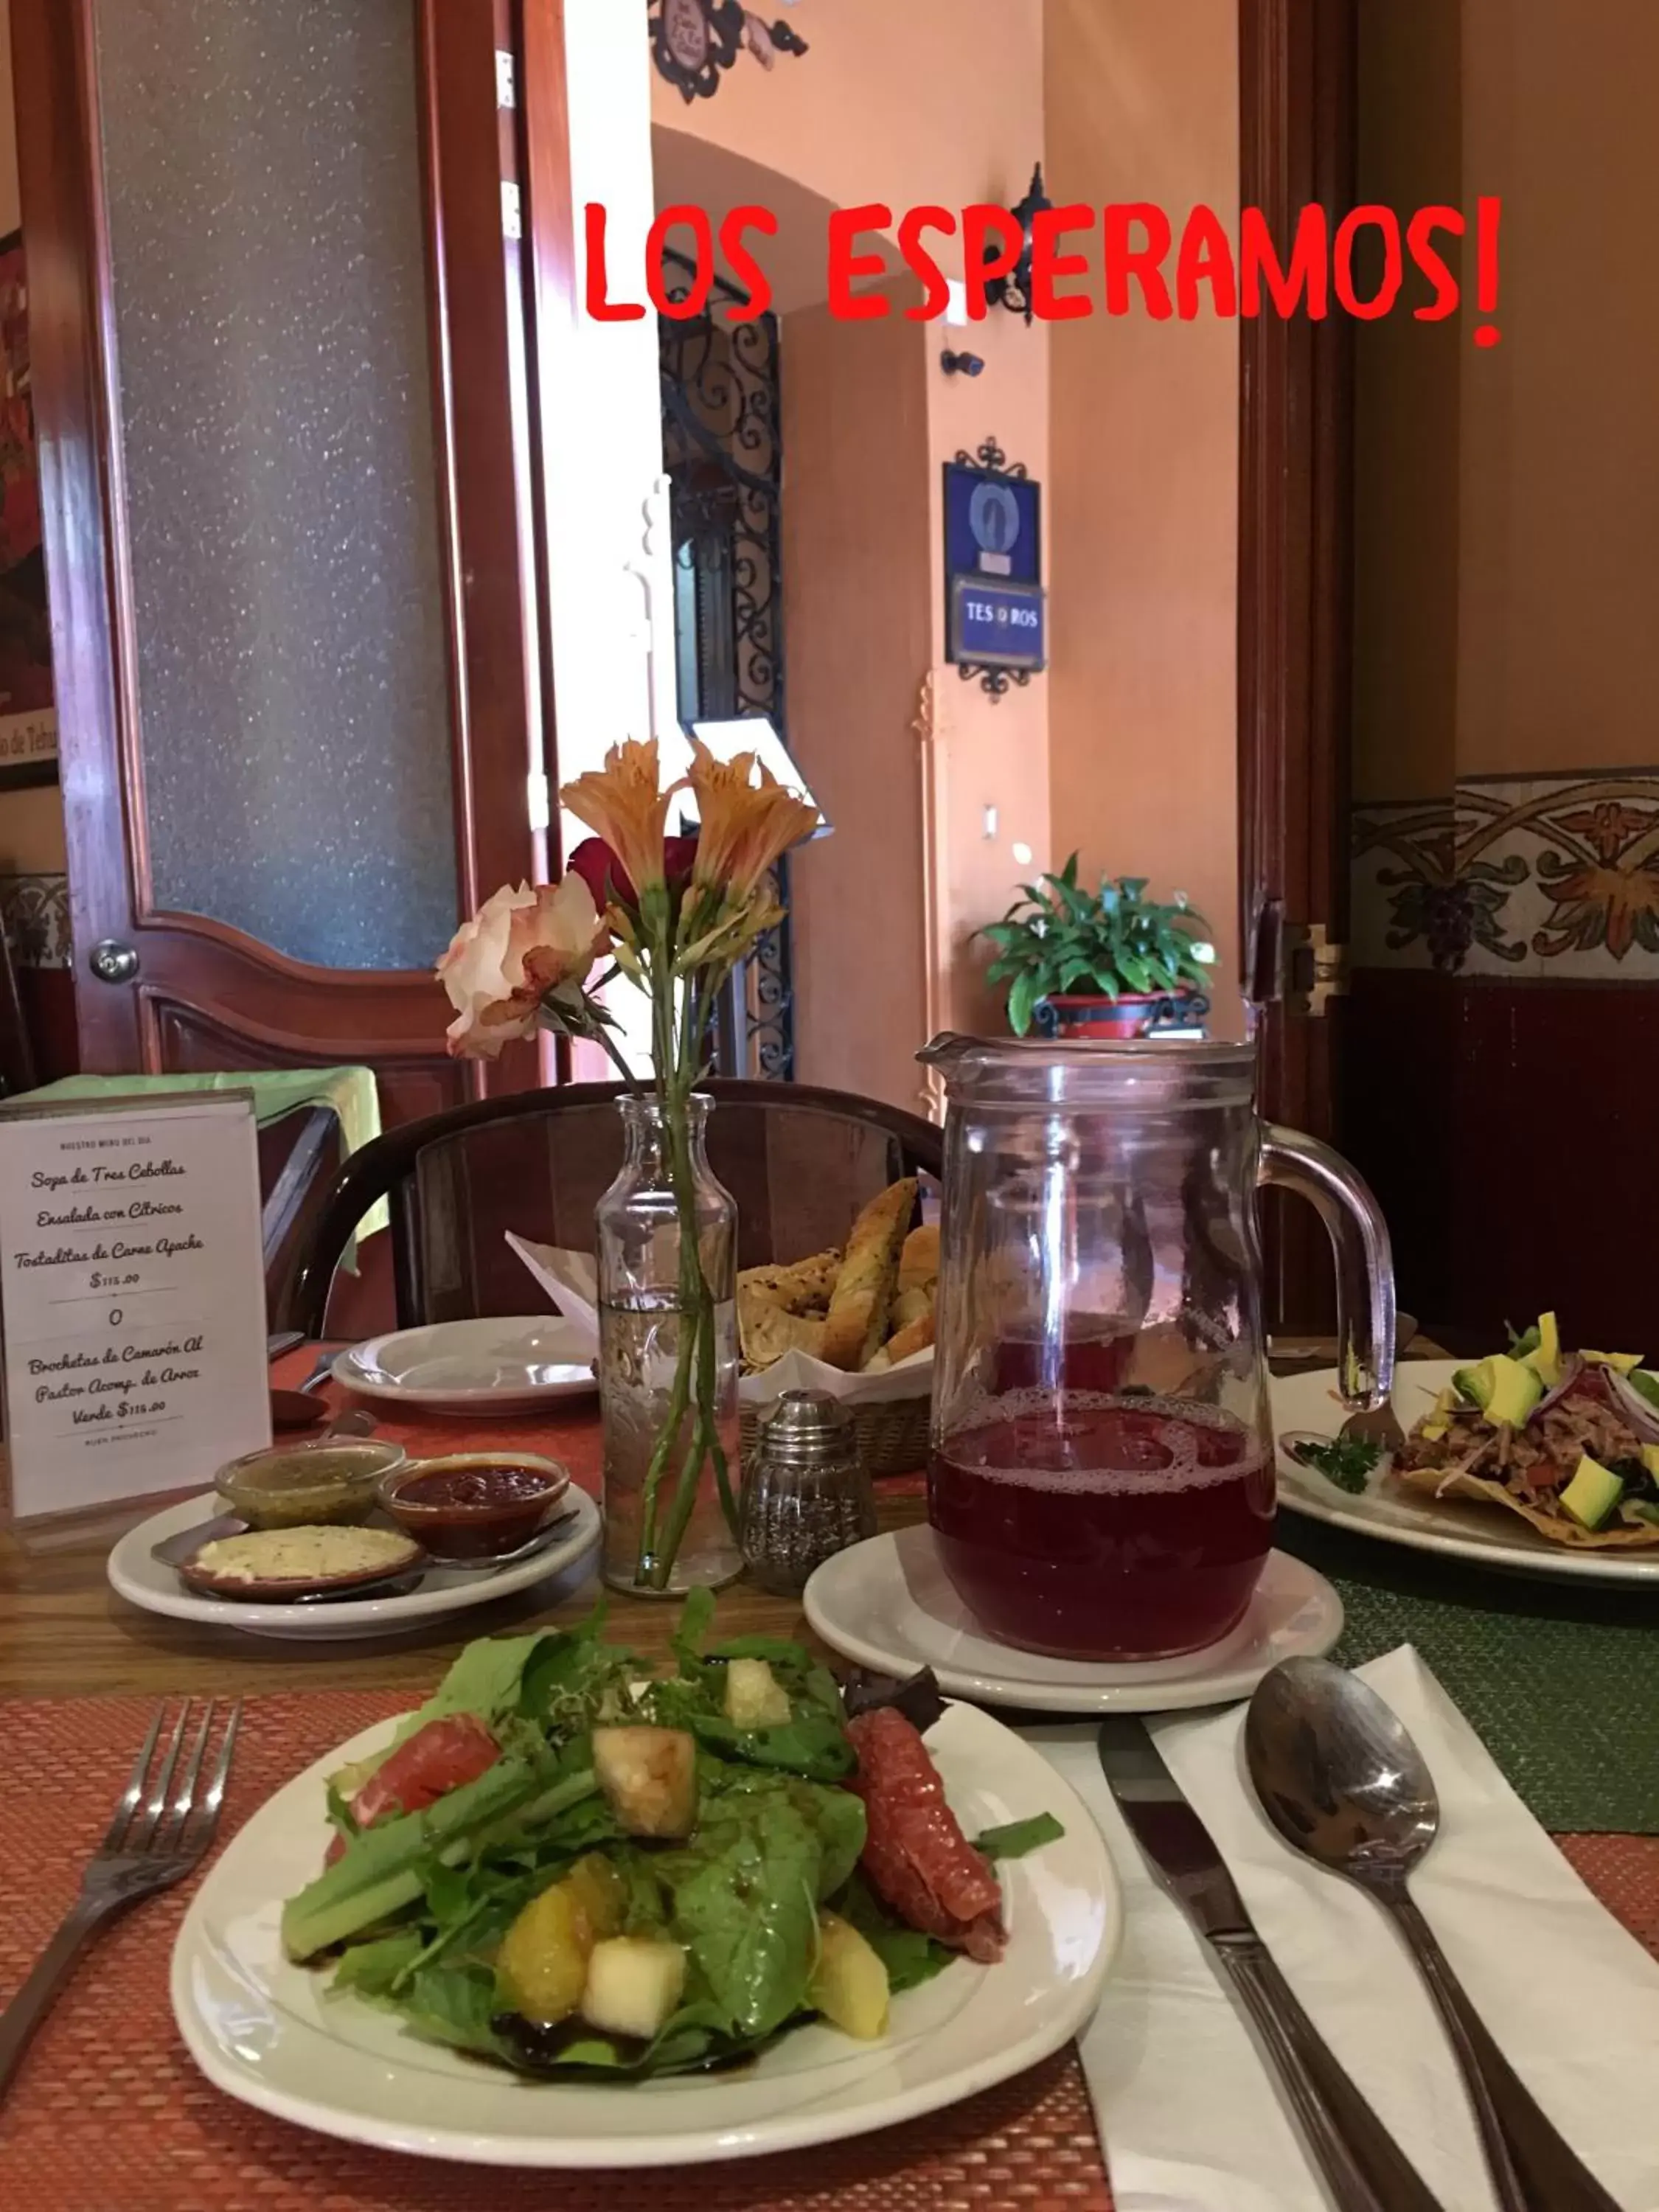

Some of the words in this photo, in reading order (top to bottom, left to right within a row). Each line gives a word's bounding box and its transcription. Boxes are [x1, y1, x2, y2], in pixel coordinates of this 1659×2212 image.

[31, 1172, 69, 1192] Sopa
[70, 1167, 89, 1183] de
[91, 1166, 126, 1185] Tres
[128, 1159, 187, 1180] Cebollas
[36, 1206, 101, 1228] Ensalada
[103, 1209, 126, 1220] con
[13, 1248, 89, 1269] Tostaditas
[91, 1243, 110, 1261] de
[111, 1242, 153, 1259] Carne
[156, 1233, 205, 1258] Apache
[27, 1354, 100, 1376] Brochetas
[102, 1346, 119, 1364] de
[122, 1340, 181, 1363] Camarón
[184, 1335, 204, 1353] Al
[35, 1382, 85, 1403] Pastor
[88, 1377, 137, 1395] Acomp.
[141, 1369, 158, 1386] de
[160, 1367, 201, 1384] Arroz
[72, 1403, 113, 1425] Verde
